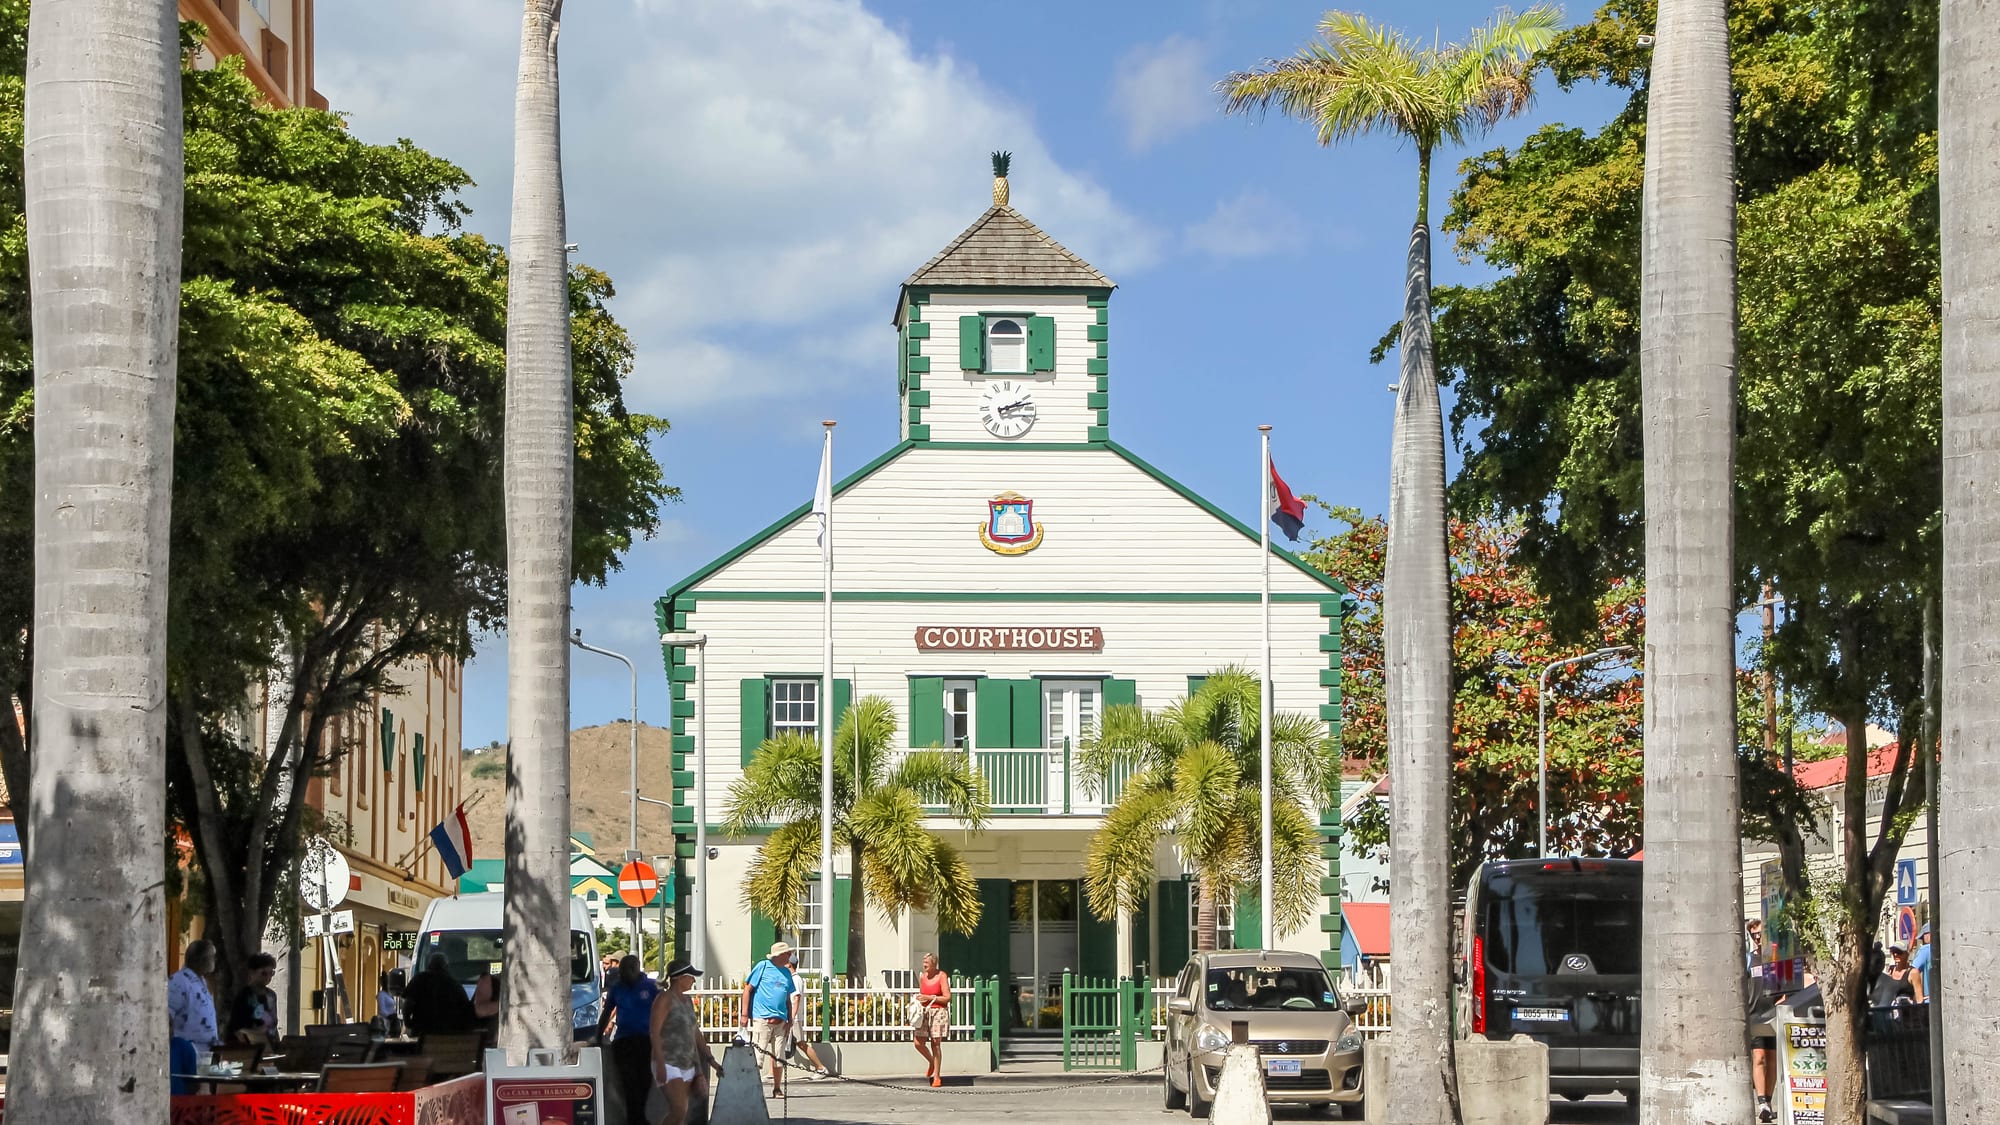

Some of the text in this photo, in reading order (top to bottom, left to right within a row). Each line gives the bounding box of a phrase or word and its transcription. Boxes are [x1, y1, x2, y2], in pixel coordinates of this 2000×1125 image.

[924, 628, 1094, 648] COURTHOUSE
[383, 940, 402, 949] FOR
[1792, 1060, 1827, 1071] SXM
